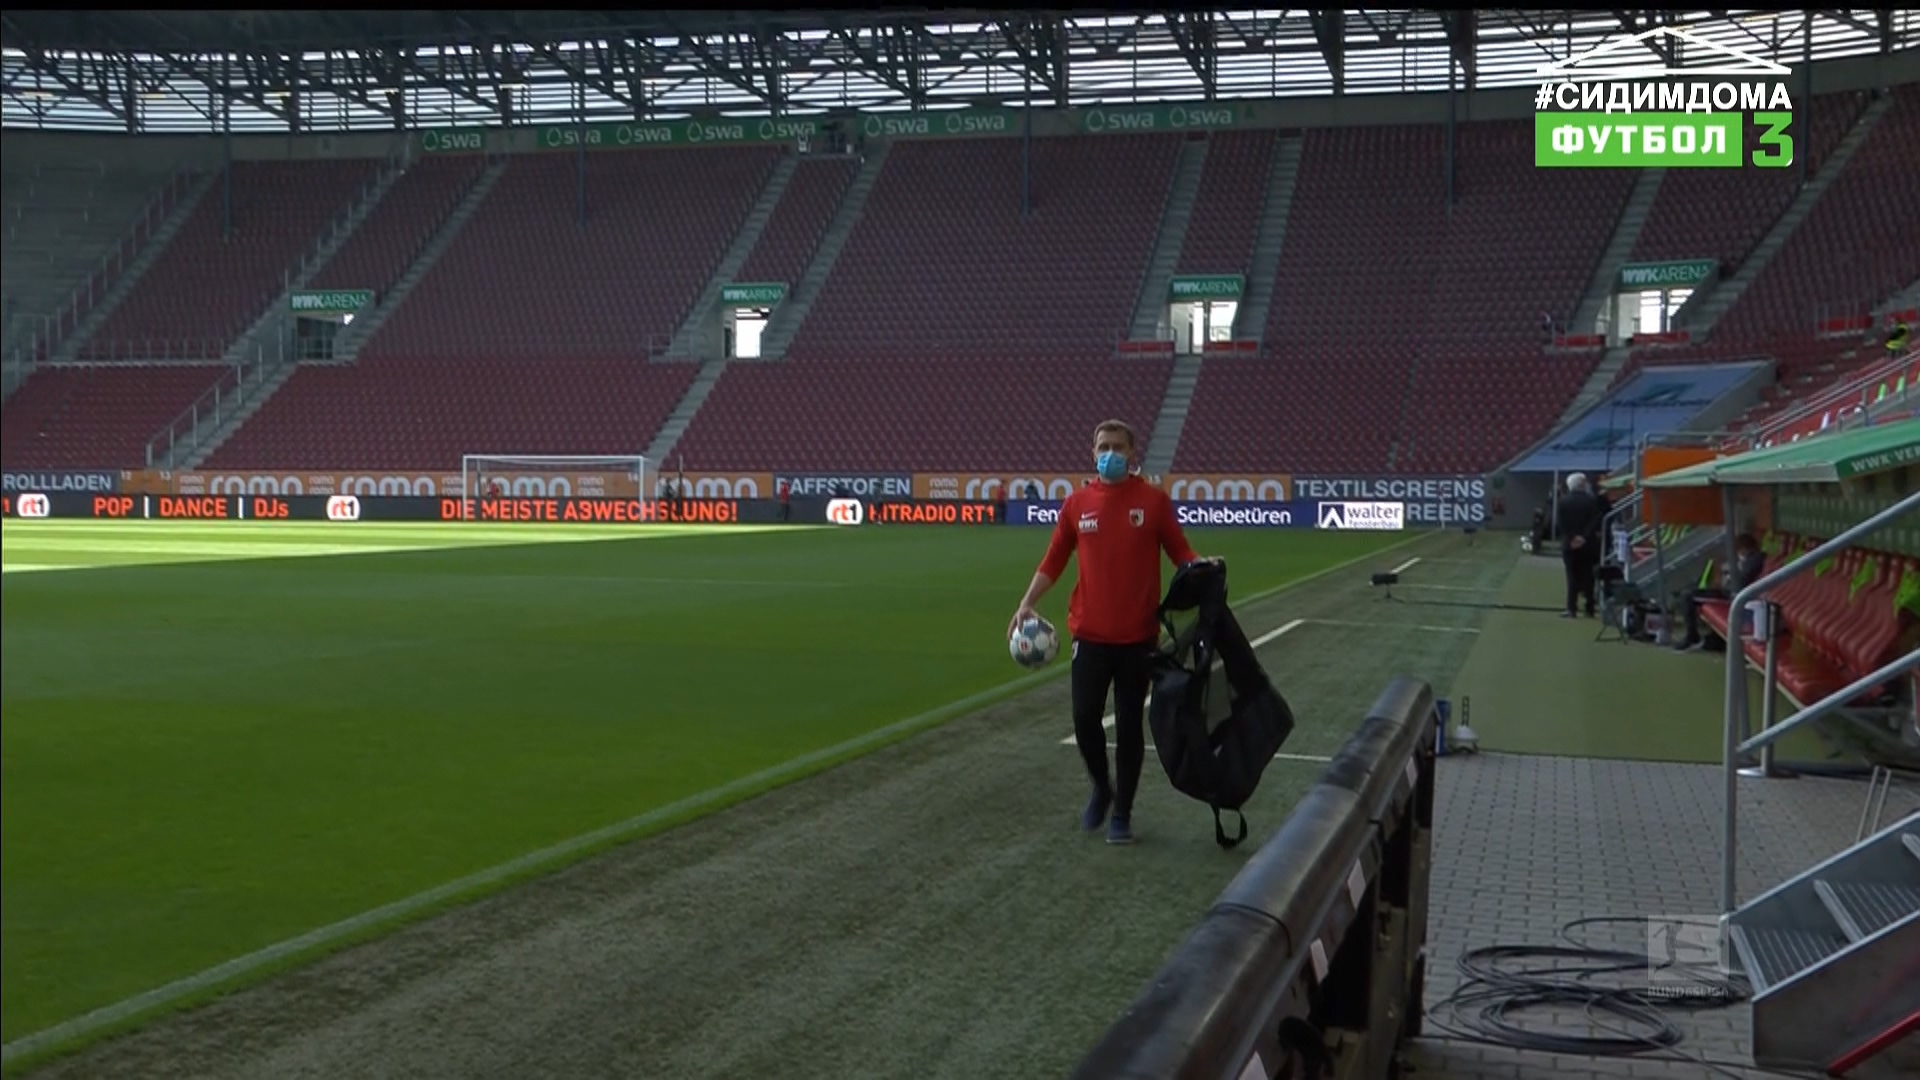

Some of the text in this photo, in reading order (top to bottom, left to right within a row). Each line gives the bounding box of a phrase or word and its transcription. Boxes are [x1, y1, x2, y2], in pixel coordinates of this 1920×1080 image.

[963, 116, 1006, 130] swa
[1107, 114, 1154, 129] swa
[1188, 109, 1232, 125] swa
[705, 125, 744, 140] swa
[774, 122, 815, 137] swa
[884, 118, 929, 133] swa
[440, 133, 481, 149] swa
[634, 128, 672, 142] swa
[1851, 453, 1890, 472] WWK
[3, 474, 112, 491] ROLLLADEN
[1295, 480, 1485, 498] TEXTILSCREENS
[23, 497, 45, 515] rt1
[94, 497, 133, 517] POP
[159, 497, 227, 518] DANCE
[254, 498, 289, 518] DJs
[333, 501, 355, 516] rt1
[441, 499, 476, 520] DIE
[481, 499, 558, 520] MEISTE
[831, 503, 858, 521] rt1
[961, 505, 995, 523] RT1
[1027, 505, 1060, 523] Fen
[1347, 504, 1400, 518] walter
